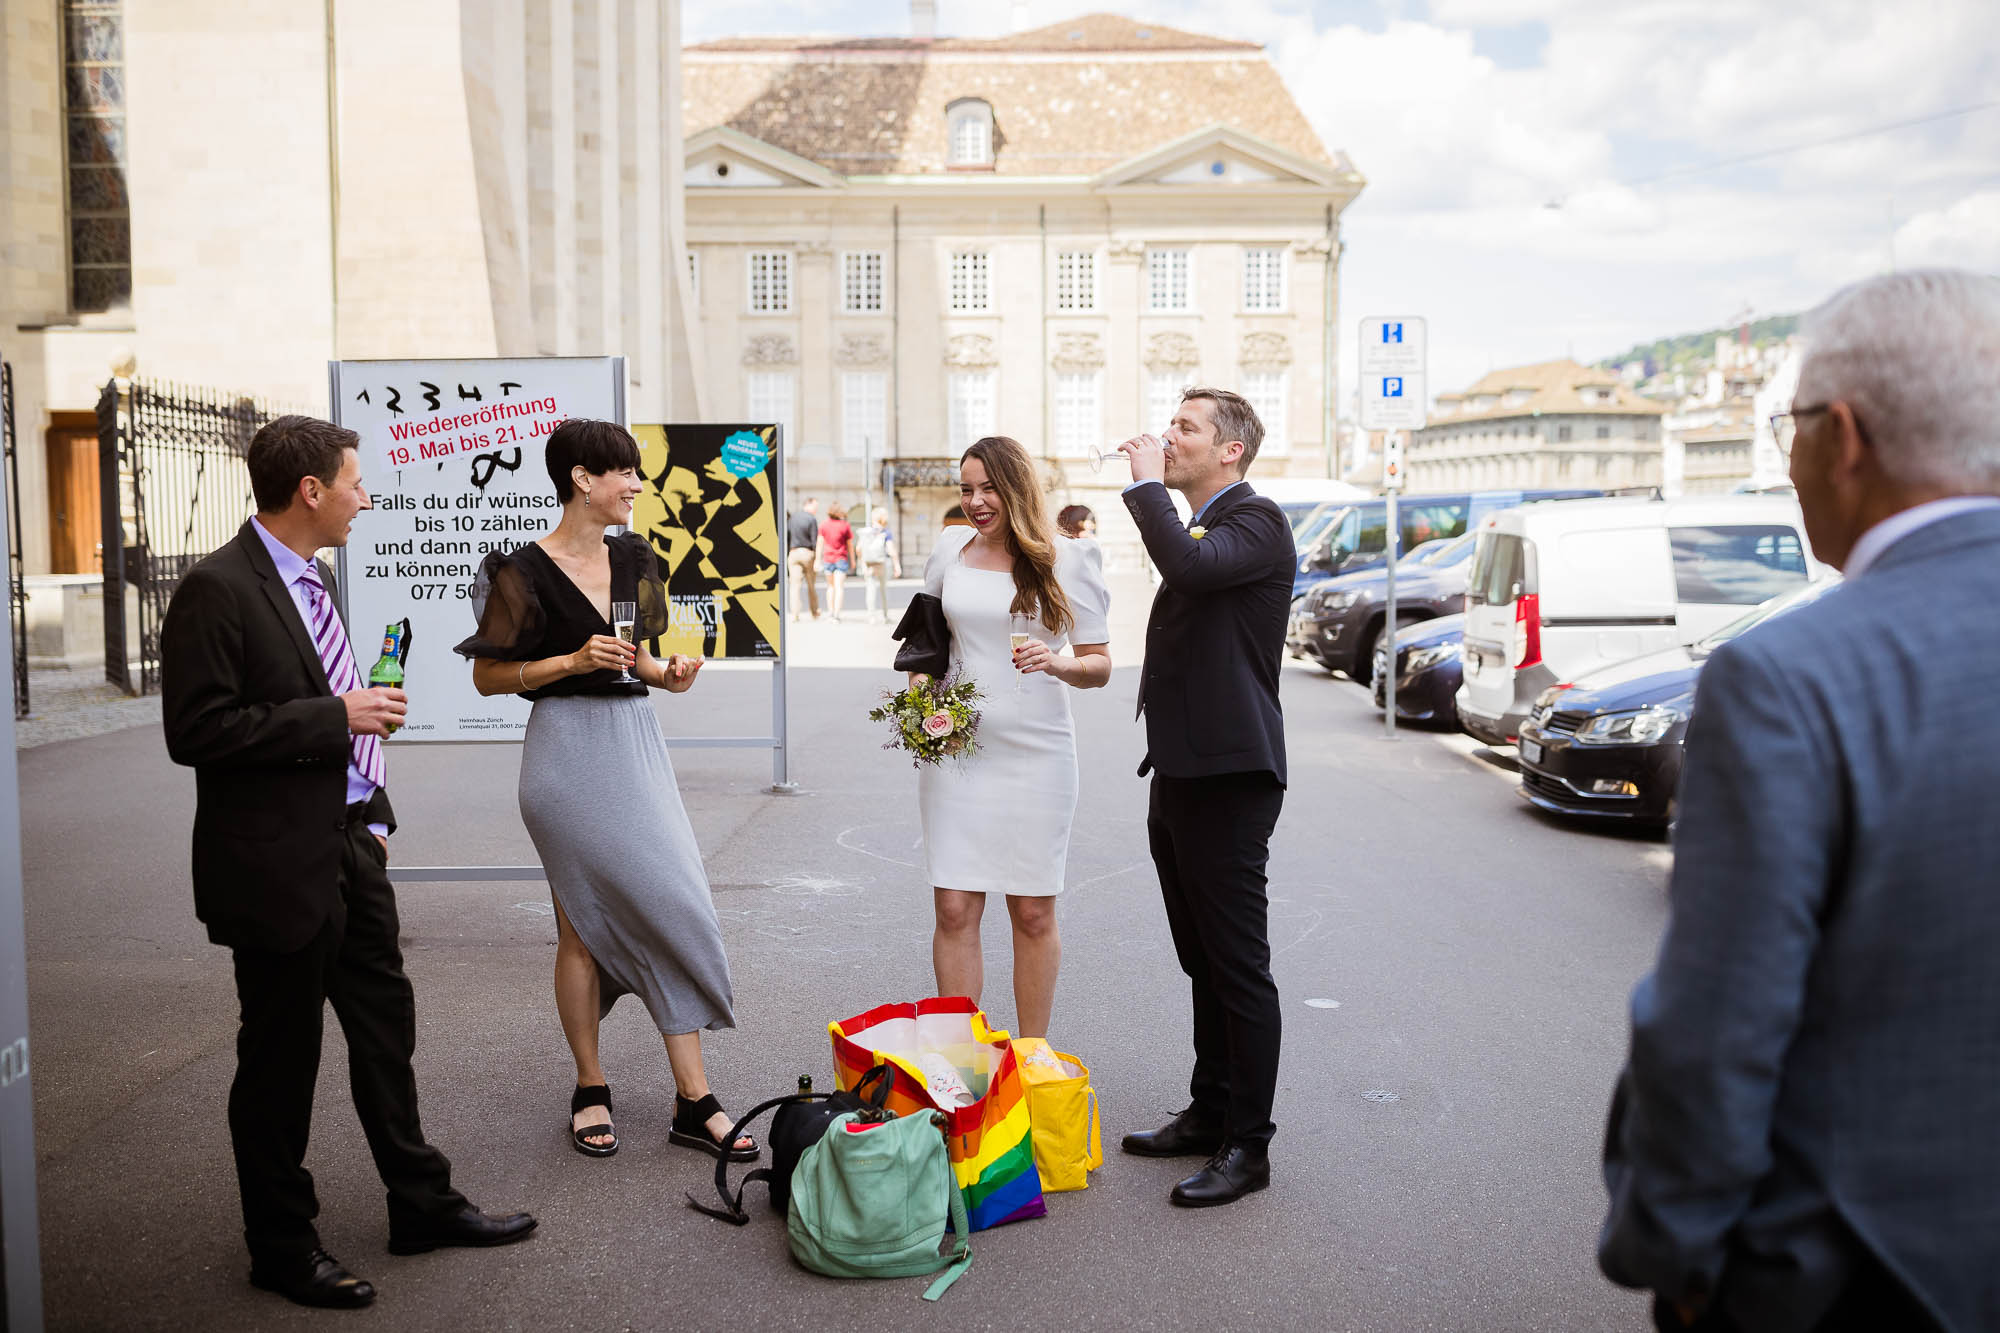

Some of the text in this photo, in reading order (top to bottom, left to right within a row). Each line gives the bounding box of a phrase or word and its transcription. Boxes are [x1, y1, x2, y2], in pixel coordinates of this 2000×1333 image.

[1386, 379, 1400, 396] P
[386, 386, 404, 414] 2
[420, 381, 441, 411] 3
[389, 397, 556, 441] Wiedereröffnung
[387, 414, 567, 466] 19. Mai bis 21. Jun
[370, 494, 416, 510] Falls
[423, 493, 448, 509] du
[456, 493, 482, 509] dir
[415, 515, 548, 532] bis 10 zählen
[375, 537, 531, 555] und dann aufw
[366, 561, 477, 580] zu können,
[411, 584, 447, 600] 077
